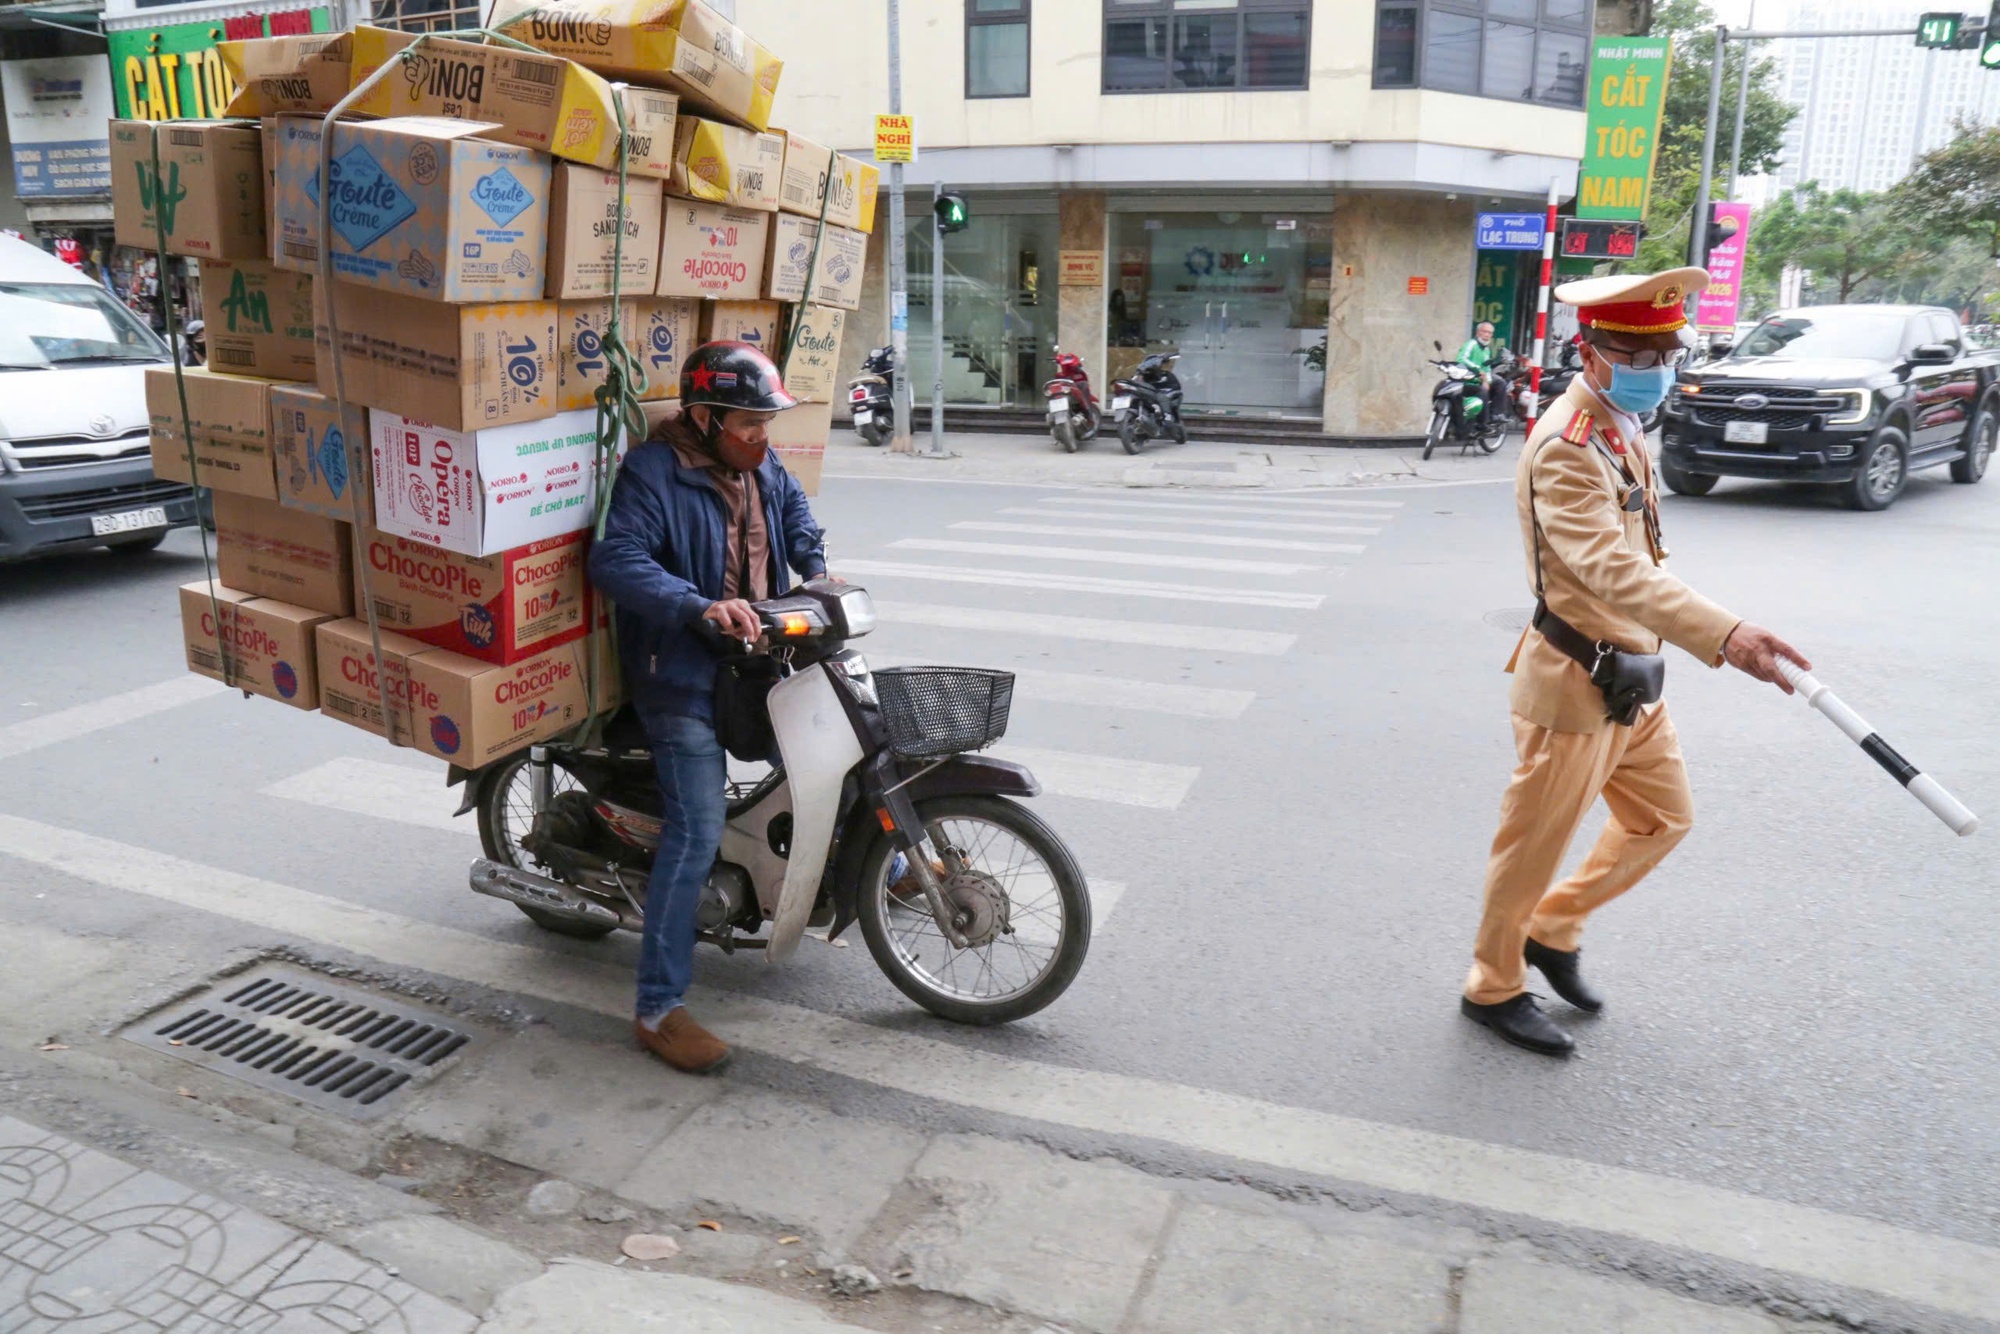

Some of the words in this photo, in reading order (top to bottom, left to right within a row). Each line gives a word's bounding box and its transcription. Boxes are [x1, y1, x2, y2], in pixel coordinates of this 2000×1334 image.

[1923, 20, 1951, 42] 41
[1632, 47, 1663, 59] MINH
[186, 28, 236, 118] TÓ
[428, 57, 484, 104] BON!
[1601, 63, 1651, 107] CẮT
[879, 116, 909, 128] NHÀ
[1596, 119, 1646, 159] TÓC
[476, 176, 524, 201] Gouté
[1581, 176, 1644, 208] NAM
[1482, 231, 1503, 246] LẠC
[1505, 231, 1539, 244] TRUNG
[683, 258, 746, 282] ChocoPie
[1476, 257, 1507, 287] ẮT
[700, 280, 721, 288] ORION
[219, 268, 273, 334] An
[1474, 298, 1503, 323] ÓC
[575, 313, 604, 378] 10%
[651, 309, 673, 370] 10%
[796, 325, 836, 352] Gouté
[506, 335, 539, 403] 10%
[407, 434, 418, 463] 10P
[431, 440, 454, 526] Opéra
[491, 475, 518, 488] ORION
[546, 465, 571, 476] ORION
[506, 488, 532, 501] ORION
[554, 478, 578, 489] ORION
[409, 473, 433, 524] Chocolate
[411, 529, 433, 541] ORION
[537, 537, 563, 551] ORION
[411, 541, 449, 561] ORION
[369, 542, 481, 598] ChocoPie
[515, 552, 580, 585] ChocoPie
[401, 608, 410, 621] 12
[524, 597, 550, 620] 10%
[569, 610, 577, 619] 12
[201, 613, 278, 657] CocoPie
[525, 658, 551, 674] ORION
[495, 661, 571, 704] ChocoPie
[512, 709, 536, 731] 10%
